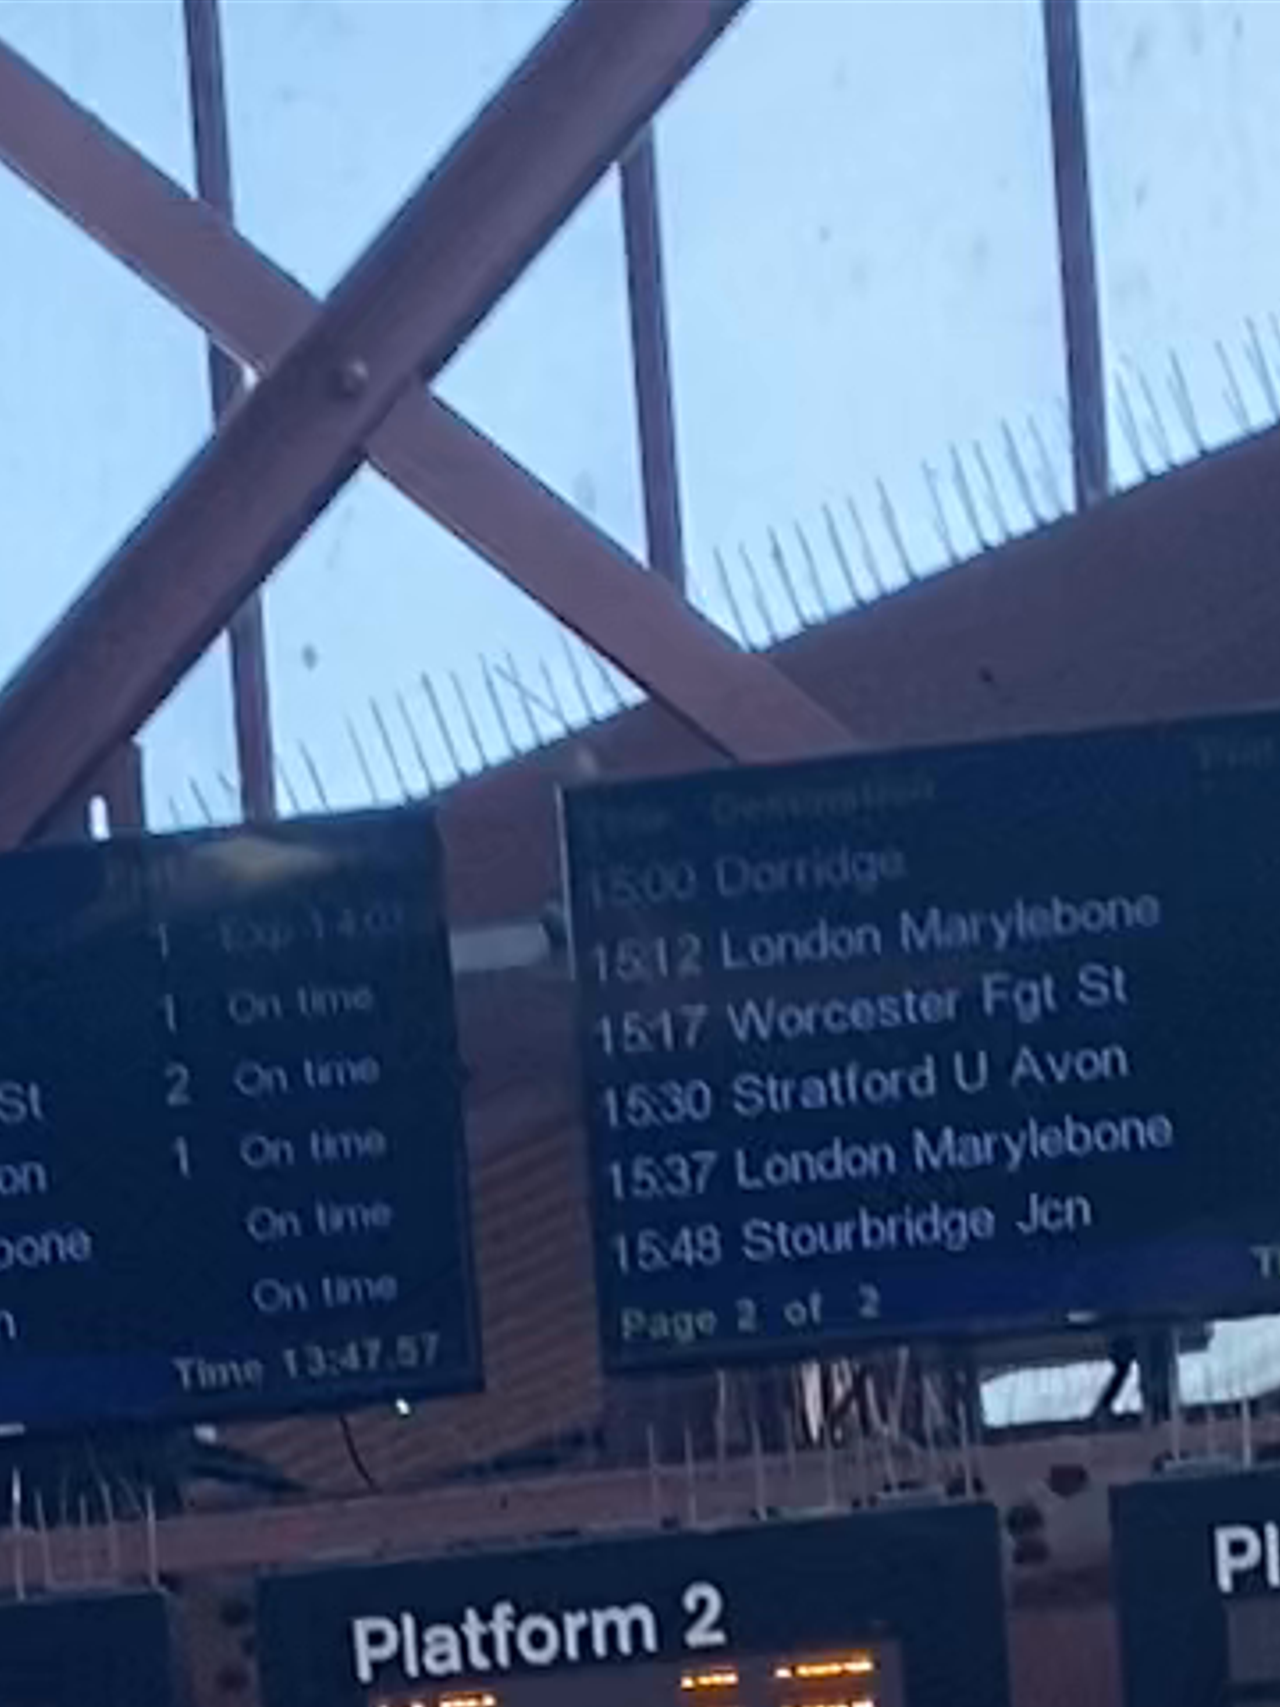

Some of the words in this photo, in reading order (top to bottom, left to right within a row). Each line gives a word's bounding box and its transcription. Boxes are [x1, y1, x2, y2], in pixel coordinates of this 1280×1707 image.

[714, 845, 908, 899] Dorridge
[720, 915, 883, 971] London
[899, 891, 1163, 953] Marylebone
[163, 993, 177, 1035] 1
[228, 990, 283, 1025] On
[297, 982, 375, 1019] time
[726, 985, 960, 1044] Worcester
[981, 970, 1057, 1024] Fgt
[1076, 962, 1129, 1005] St
[164, 1061, 193, 1109] 2
[232, 1059, 290, 1098] On
[303, 1053, 382, 1090] time
[732, 1055, 938, 1121] Stratford
[953, 1051, 988, 1094] U
[1010, 1042, 1131, 1088] Avon
[171, 1134, 193, 1181] 1
[239, 1134, 296, 1170] On
[309, 1127, 388, 1165] time
[734, 1138, 896, 1192] London
[912, 1111, 1174, 1174] Marylebone
[244, 1204, 303, 1244] On
[315, 1195, 395, 1236] time
[741, 1203, 995, 1262] Stourbridge
[1015, 1192, 1093, 1236] Jcn
[252, 1277, 309, 1314] On
[322, 1273, 399, 1308] time
[622, 1307, 717, 1343] Page
[735, 1297, 757, 1332] 2
[783, 1286, 823, 1329] of
[857, 1282, 881, 1319] 2
[170, 1355, 264, 1393] Time
[352, 1599, 659, 1683] Platform
[683, 1581, 726, 1647] 2
